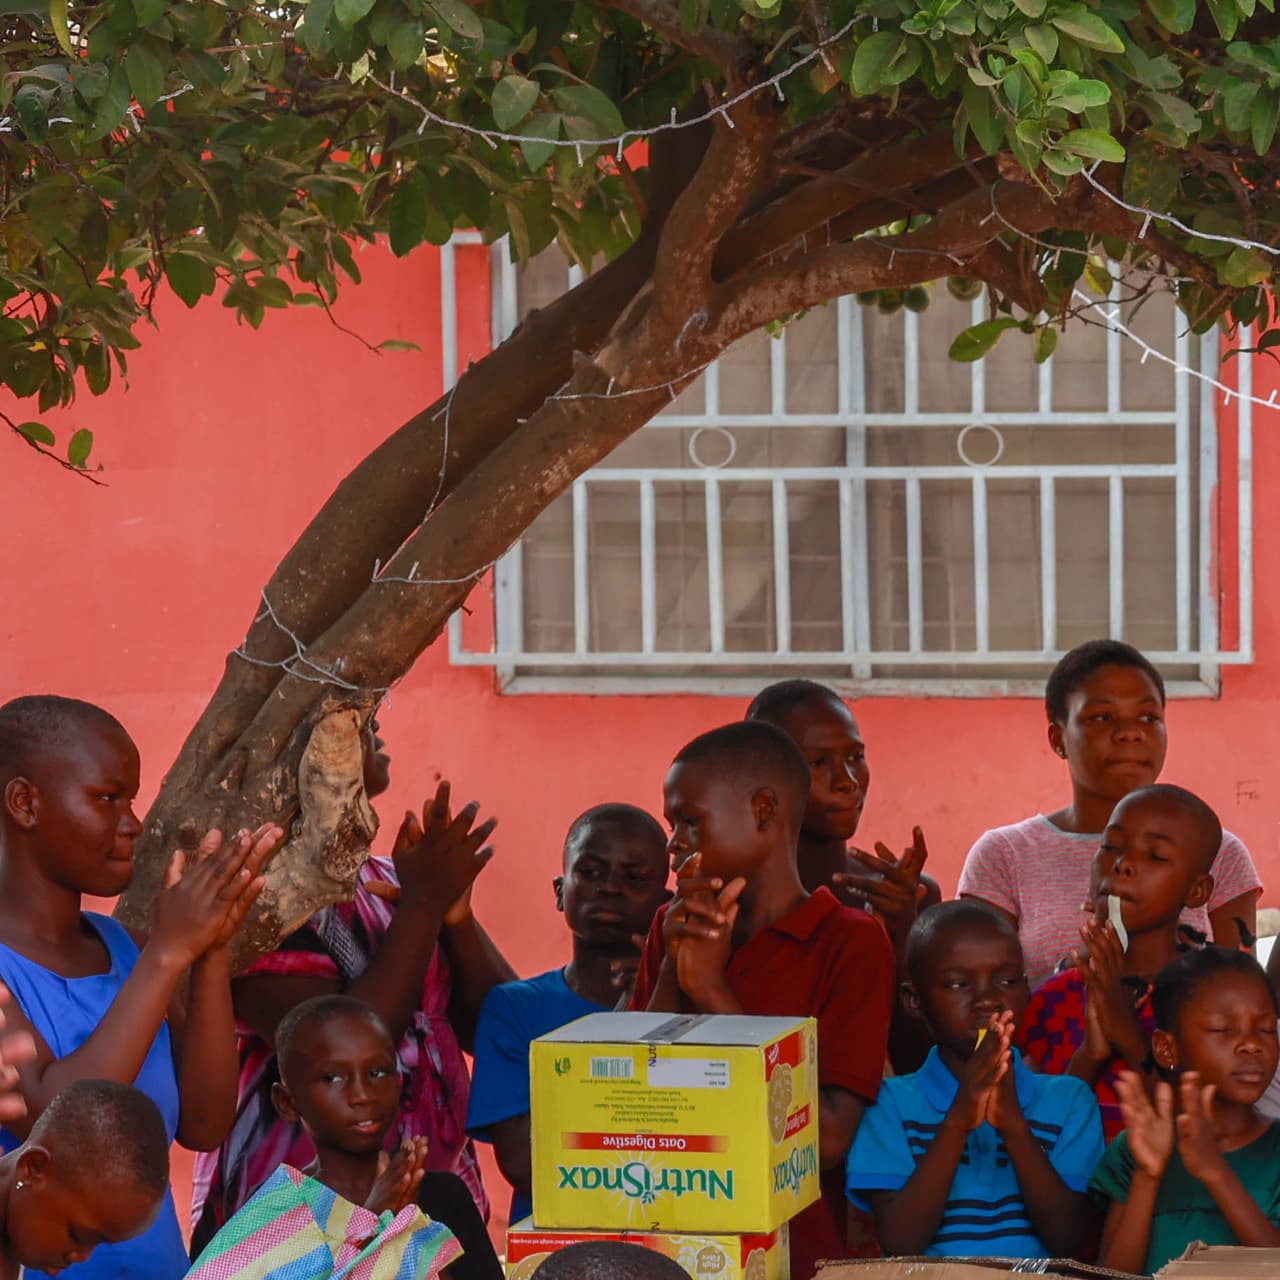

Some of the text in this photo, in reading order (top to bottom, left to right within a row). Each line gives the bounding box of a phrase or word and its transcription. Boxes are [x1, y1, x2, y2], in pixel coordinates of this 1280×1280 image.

[602, 1135, 686, 1149] Oats Digestive
[558, 1161, 735, 1204] NutriSnax
